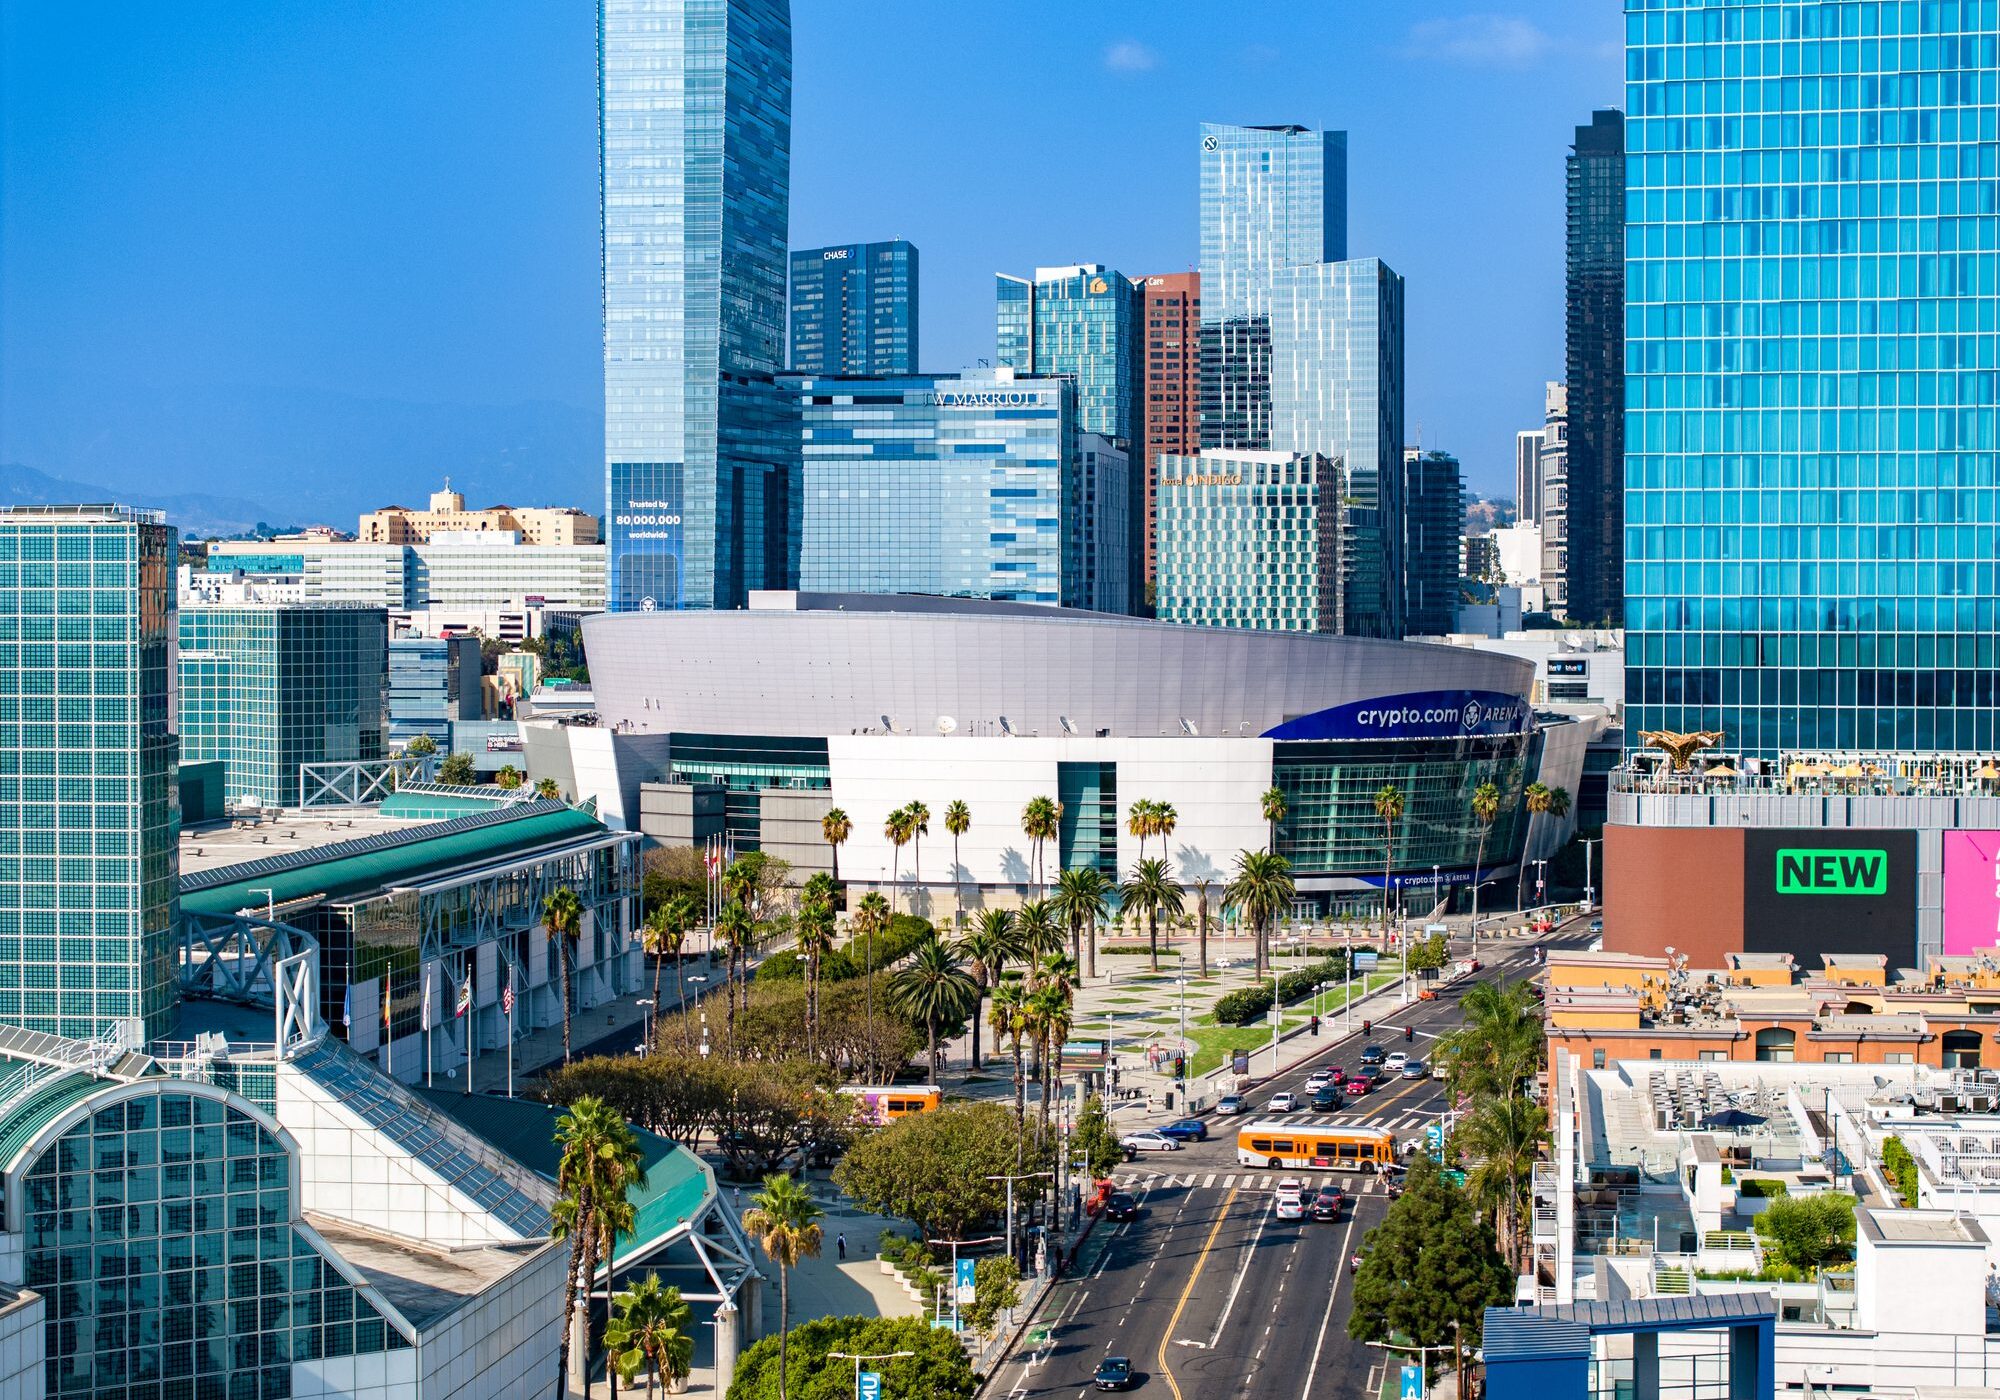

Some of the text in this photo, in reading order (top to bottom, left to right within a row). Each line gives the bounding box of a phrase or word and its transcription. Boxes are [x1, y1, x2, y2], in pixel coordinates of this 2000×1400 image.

[824, 250, 848, 260] CHASE
[1148, 277, 1164, 286] Care
[924, 391, 1045, 406] JW MARRIOTT
[1196, 474, 1242, 486] INDIGO
[658, 500, 668, 509] by
[616, 516, 680, 526] 80,000,000
[1357, 706, 1518, 727] crypto.com ARENA
[1782, 856, 1882, 888] NEW
[1404, 876, 1444, 885] crypto.com
